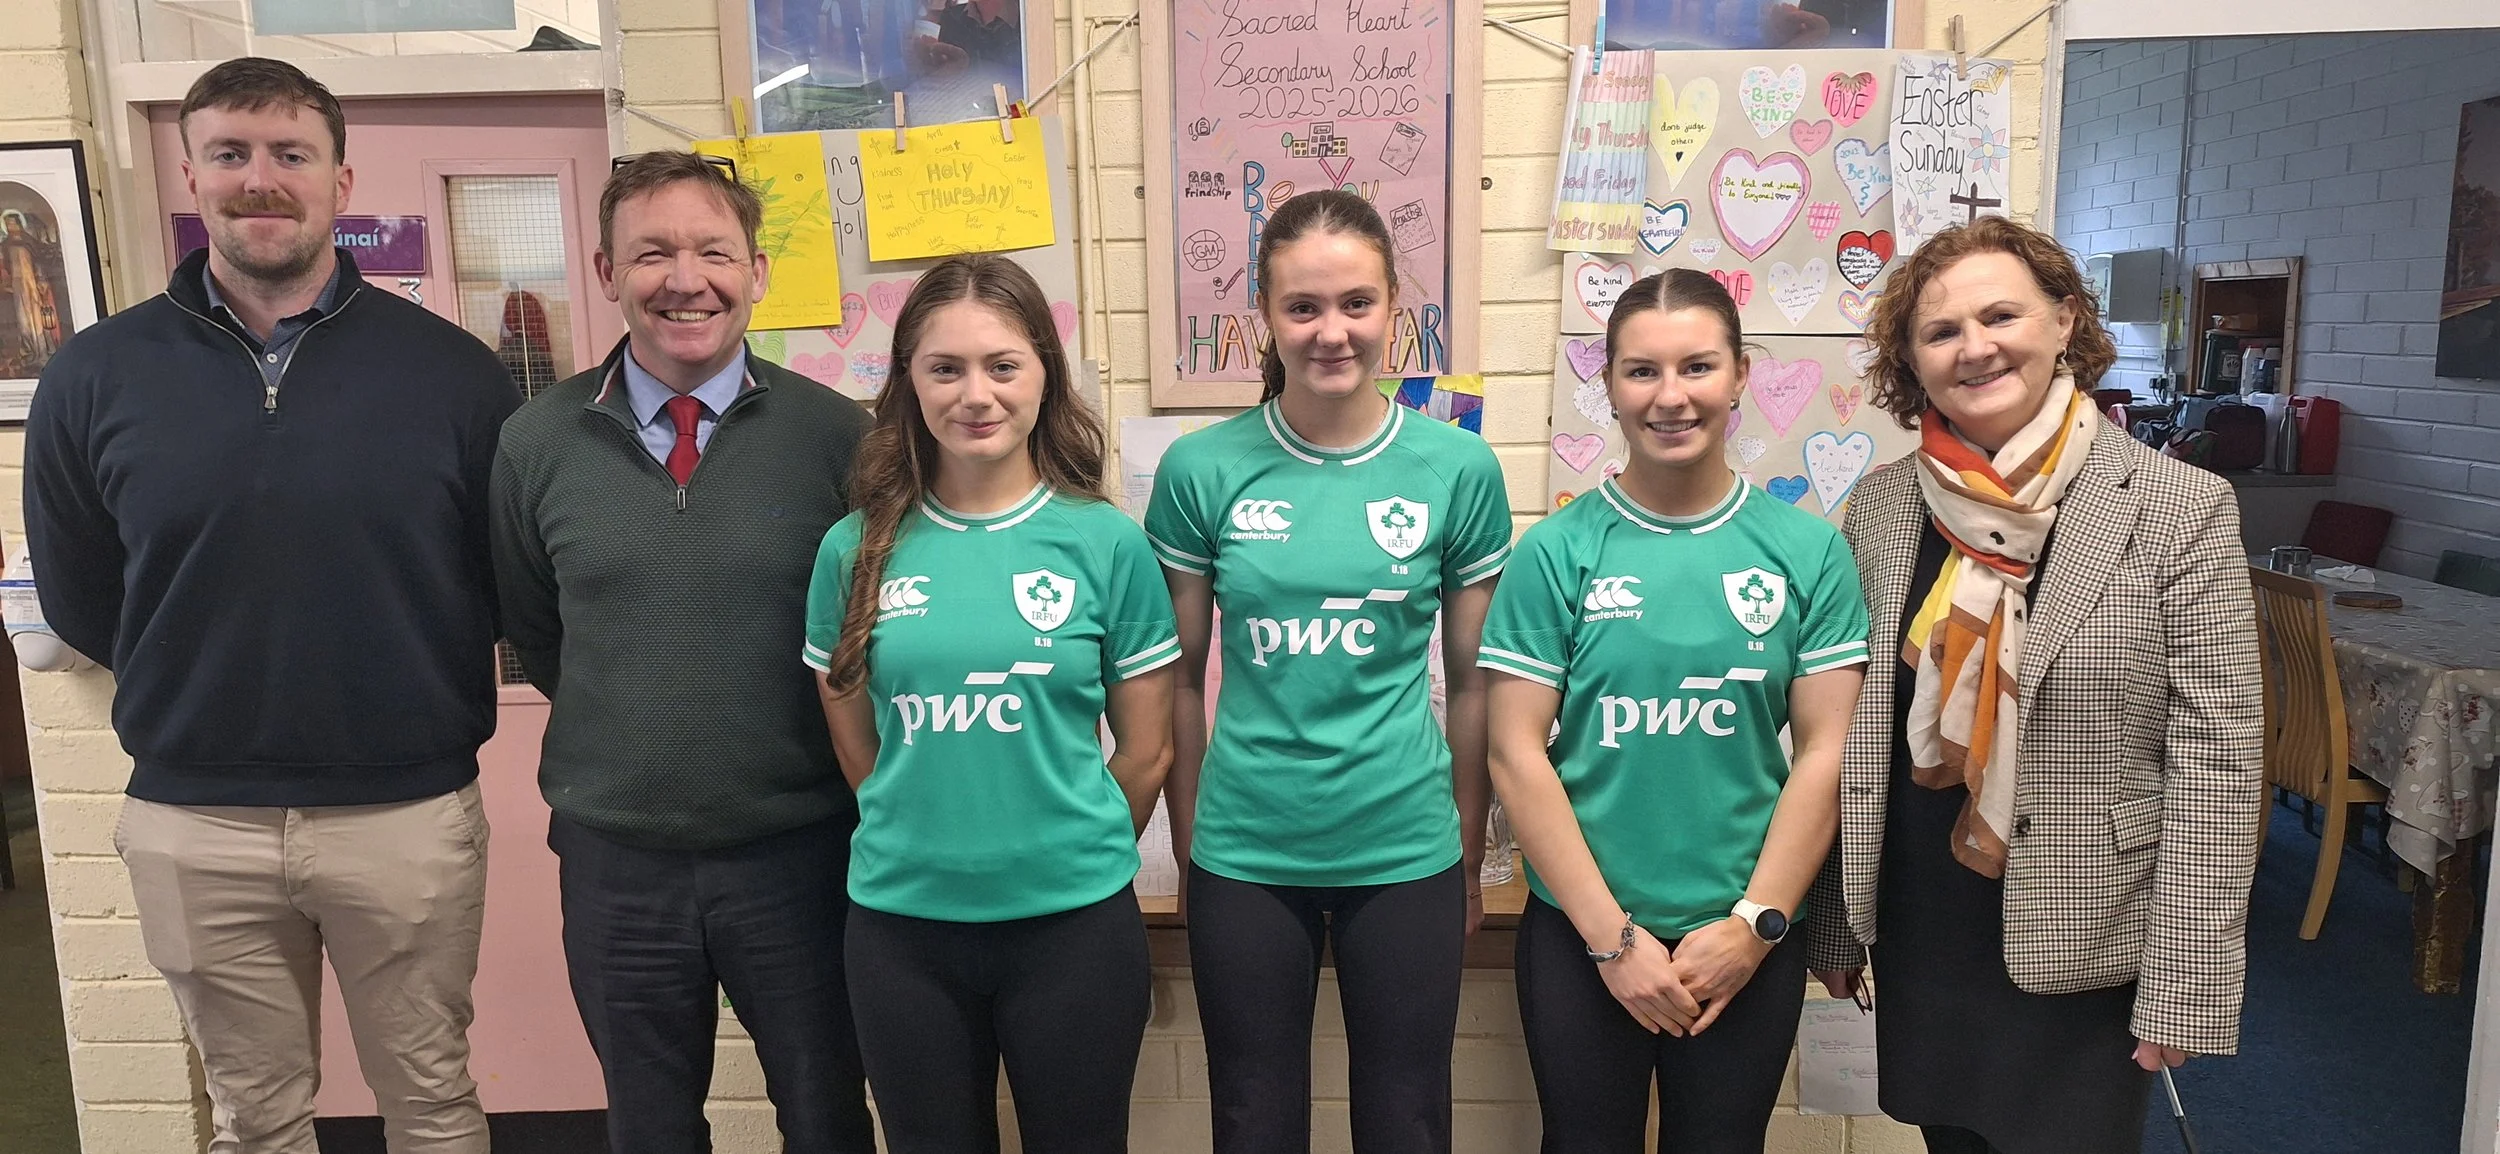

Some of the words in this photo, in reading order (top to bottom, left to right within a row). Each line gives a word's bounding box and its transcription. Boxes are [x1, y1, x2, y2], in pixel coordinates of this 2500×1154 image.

[1218, 0, 1318, 38] Sacred
[1346, 0, 1412, 33] Heart
[1214, 42, 1334, 92] Secondary
[1350, 45, 1416, 81] School
[1239, 85, 1419, 118] 2025-2026
[1752, 87, 1776, 103] BE
[1901, 74, 1983, 127] Easter
[1751, 106, 1794, 121] KIND
[1684, 123, 1706, 133] judge
[1900, 130, 1965, 196] Sunday
[1244, 161, 1295, 212] Be
[1593, 168, 1636, 196] Friday
[1185, 187, 1231, 200] Frindship
[1646, 216, 1662, 224] BE
[335, 227, 379, 246] únaí
[1589, 275, 1599, 285] Be
[1598, 289, 1607, 297] to
[1188, 314, 1271, 374] HAV
[1382, 304, 1442, 373] EAR
[1230, 531, 1290, 543] canterbury
[1387, 539, 1413, 549] IRFU
[877, 607, 928, 623] canterbury
[1031, 611, 1058, 622] IRFU
[1584, 608, 1643, 623] canterbury
[1745, 613, 1770, 624] IRFU
[1246, 617, 1376, 667] pwc
[891, 693, 1022, 746] pwc
[1598, 695, 1737, 749] pwc
